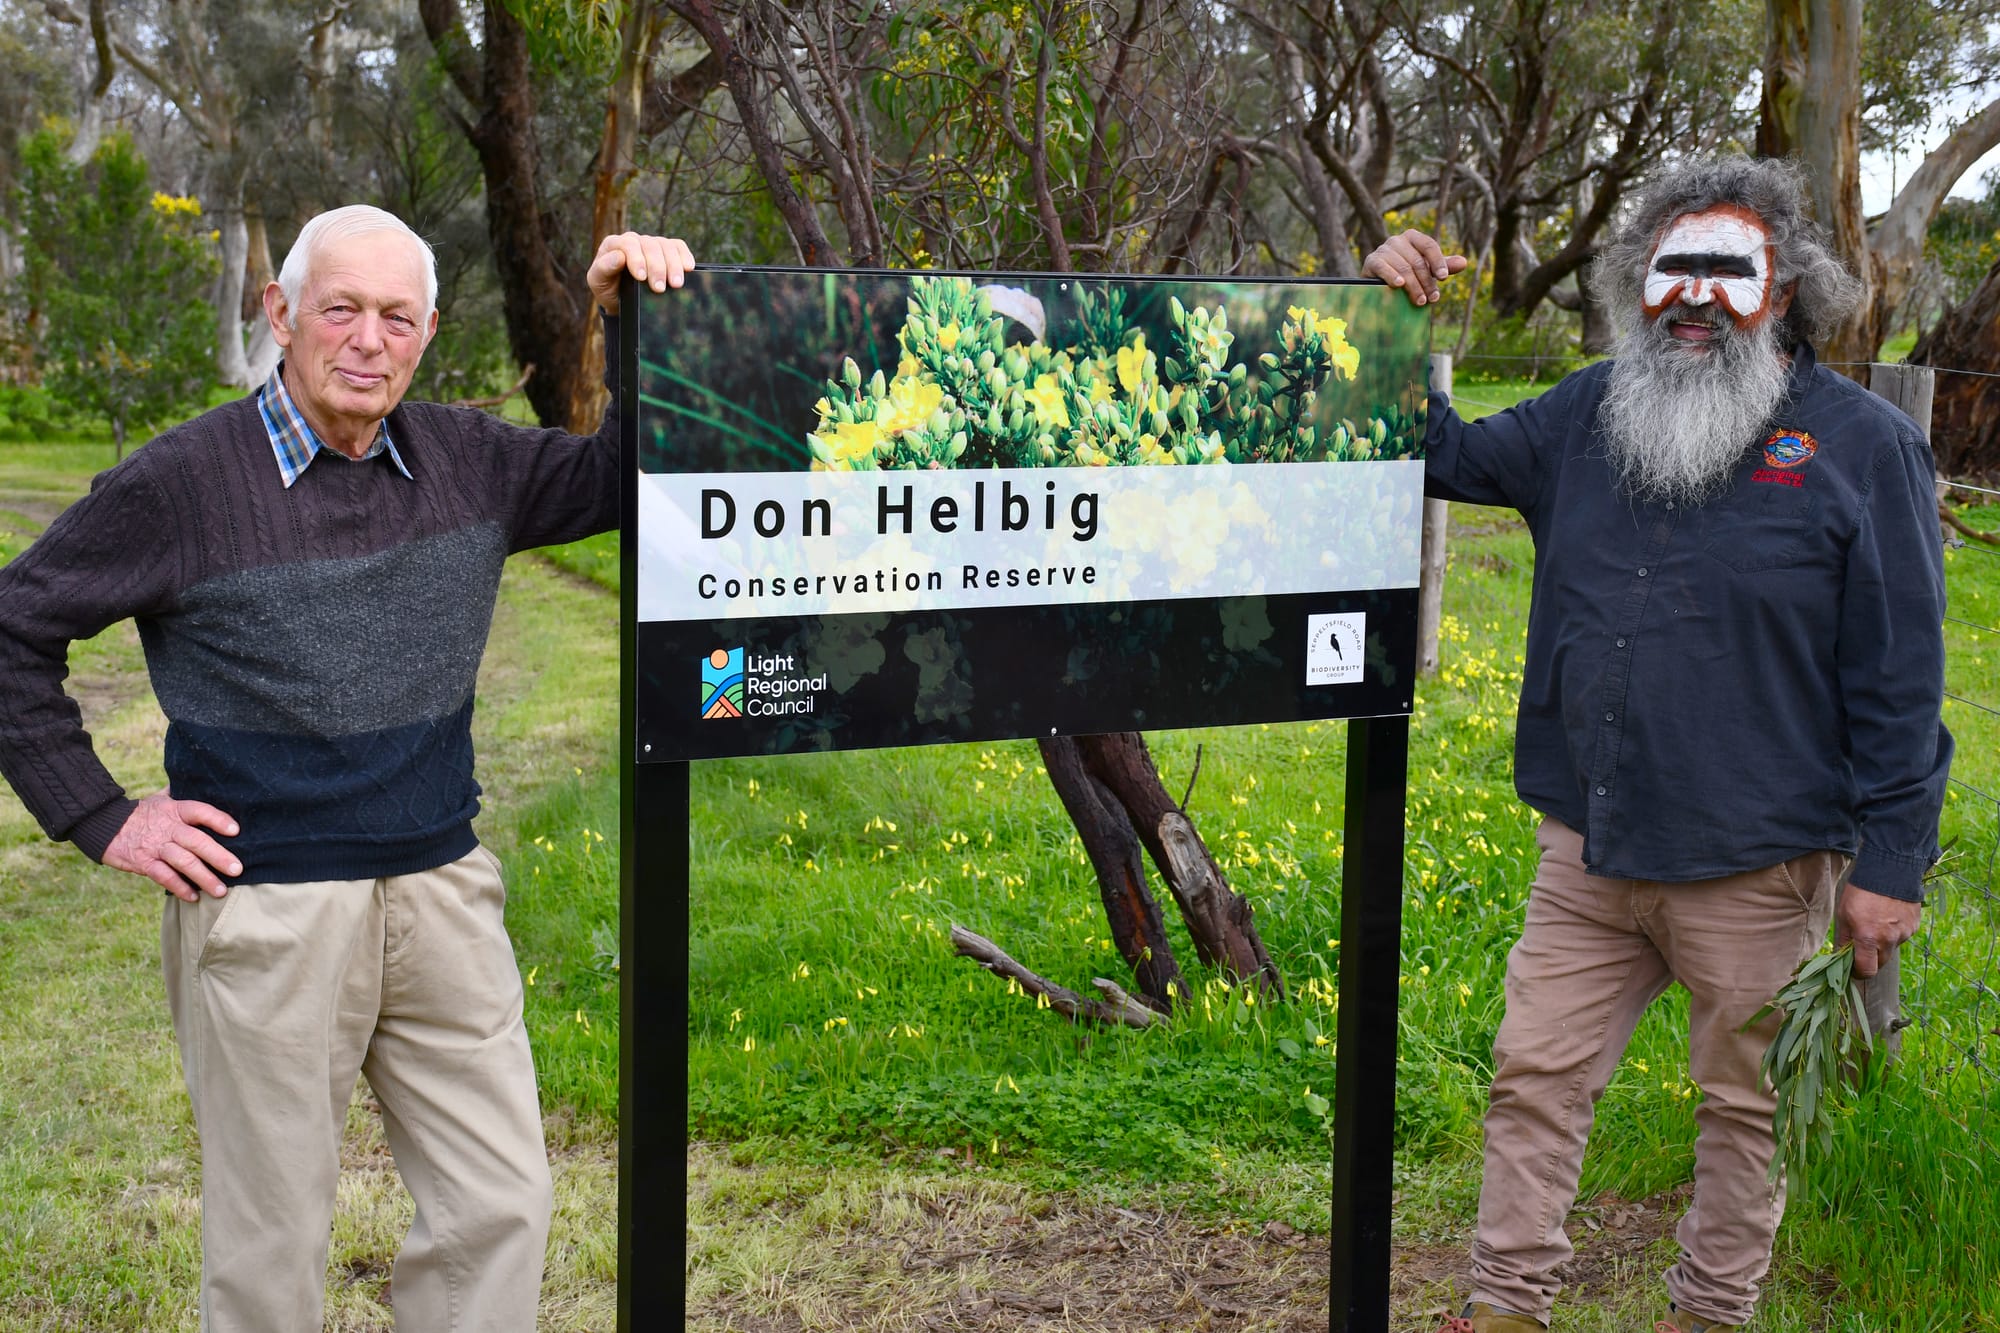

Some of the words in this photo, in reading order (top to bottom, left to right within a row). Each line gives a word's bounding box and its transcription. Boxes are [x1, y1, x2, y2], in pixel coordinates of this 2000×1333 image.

[701, 488, 831, 539] Don
[877, 481, 1099, 542] Helbig
[698, 567, 942, 599] Conservation
[962, 565, 1096, 589] Reserve
[1311, 620, 1351, 652] SEPPELTSFIELD
[1352, 629, 1361, 651] ROAD
[748, 654, 794, 676] Light
[1311, 665, 1360, 673] BIODIVERSITY
[748, 672, 827, 697] Regional
[747, 695, 814, 716] Council
